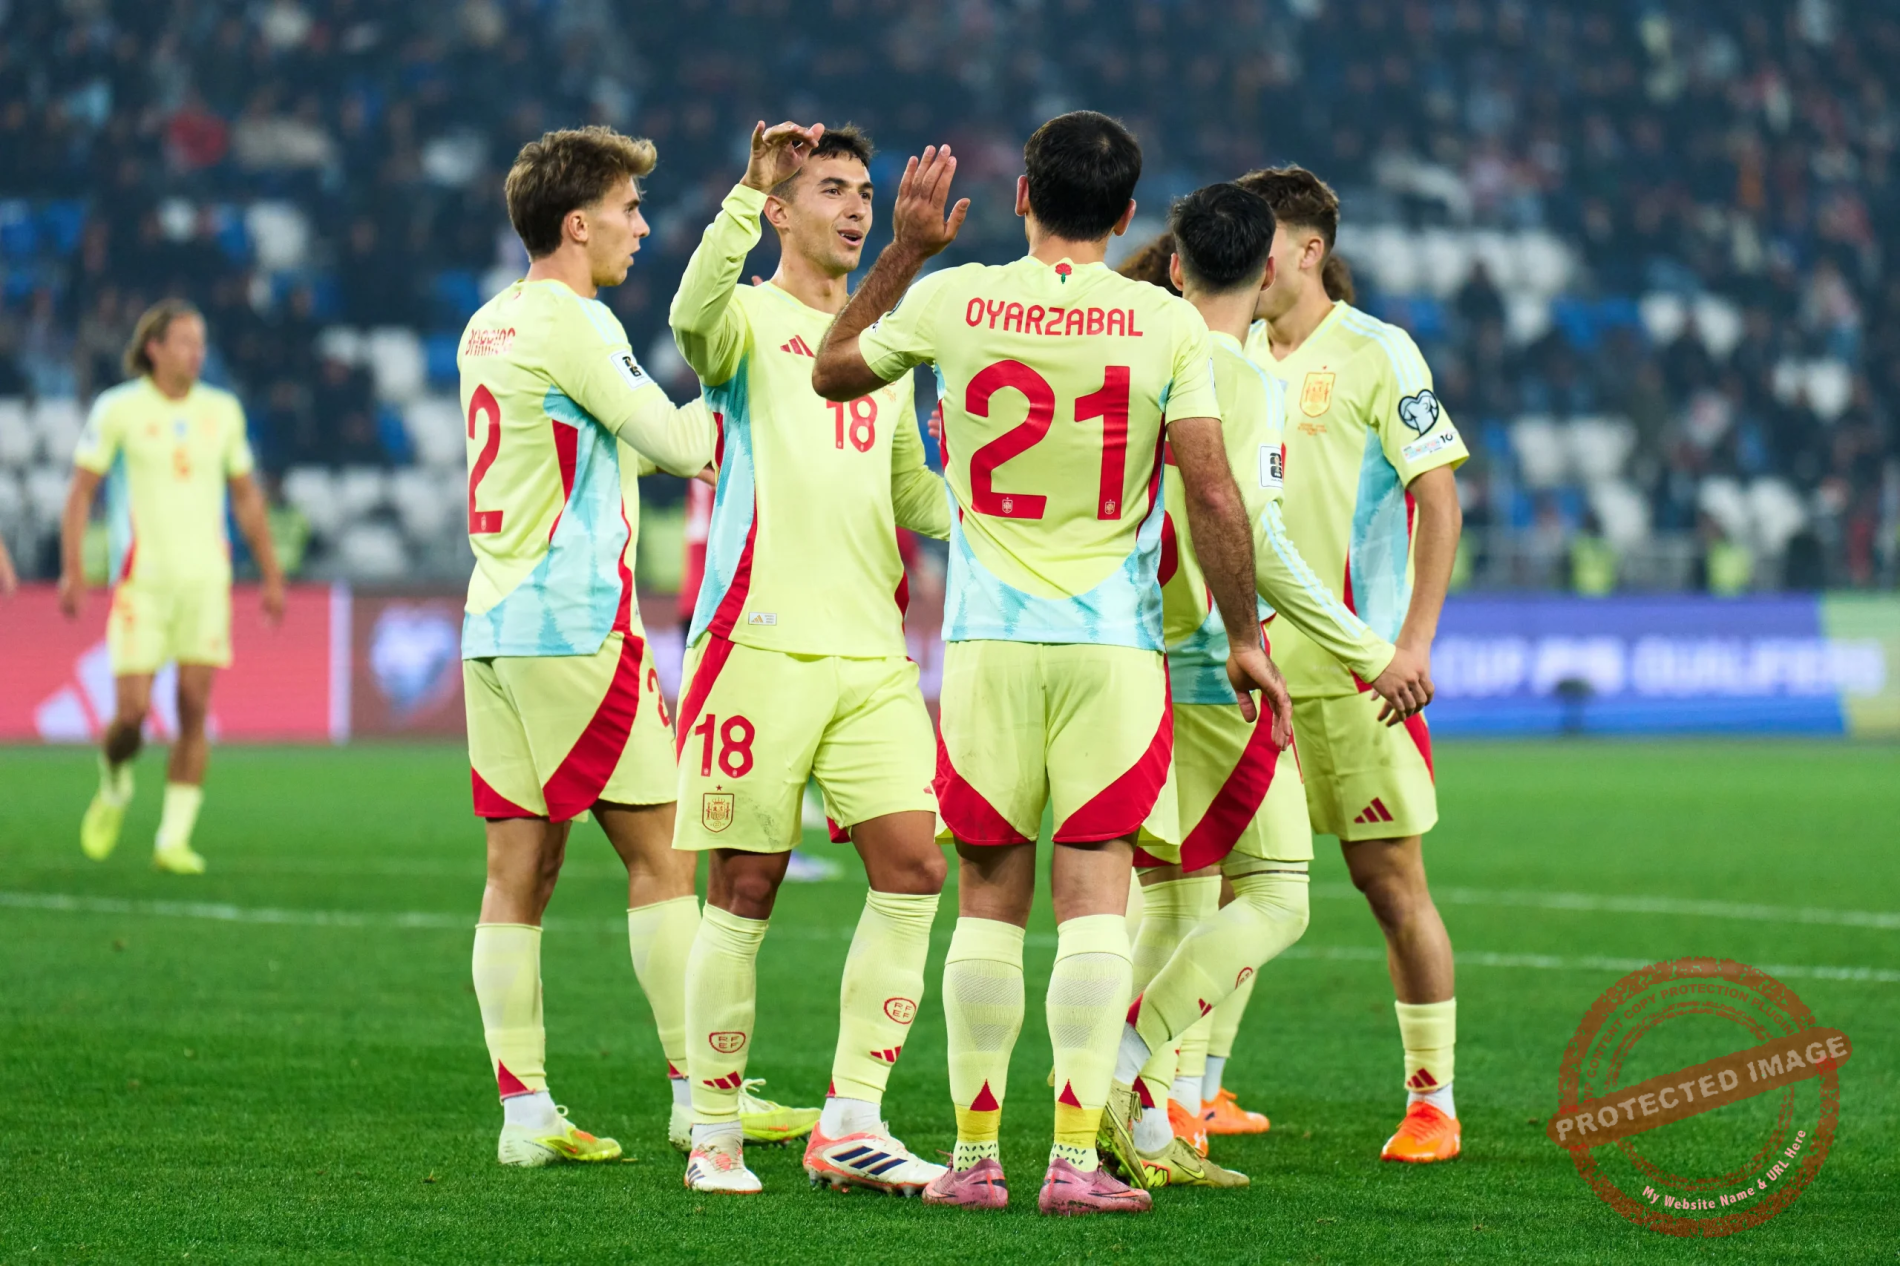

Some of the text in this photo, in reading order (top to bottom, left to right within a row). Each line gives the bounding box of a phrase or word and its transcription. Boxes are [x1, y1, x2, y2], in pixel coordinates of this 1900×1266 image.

[965, 297, 1143, 337] OYARZABAL
[826, 394, 878, 453] 18
[965, 359, 1131, 520] 21
[468, 383, 504, 534] 2
[695, 714, 755, 779] 18
